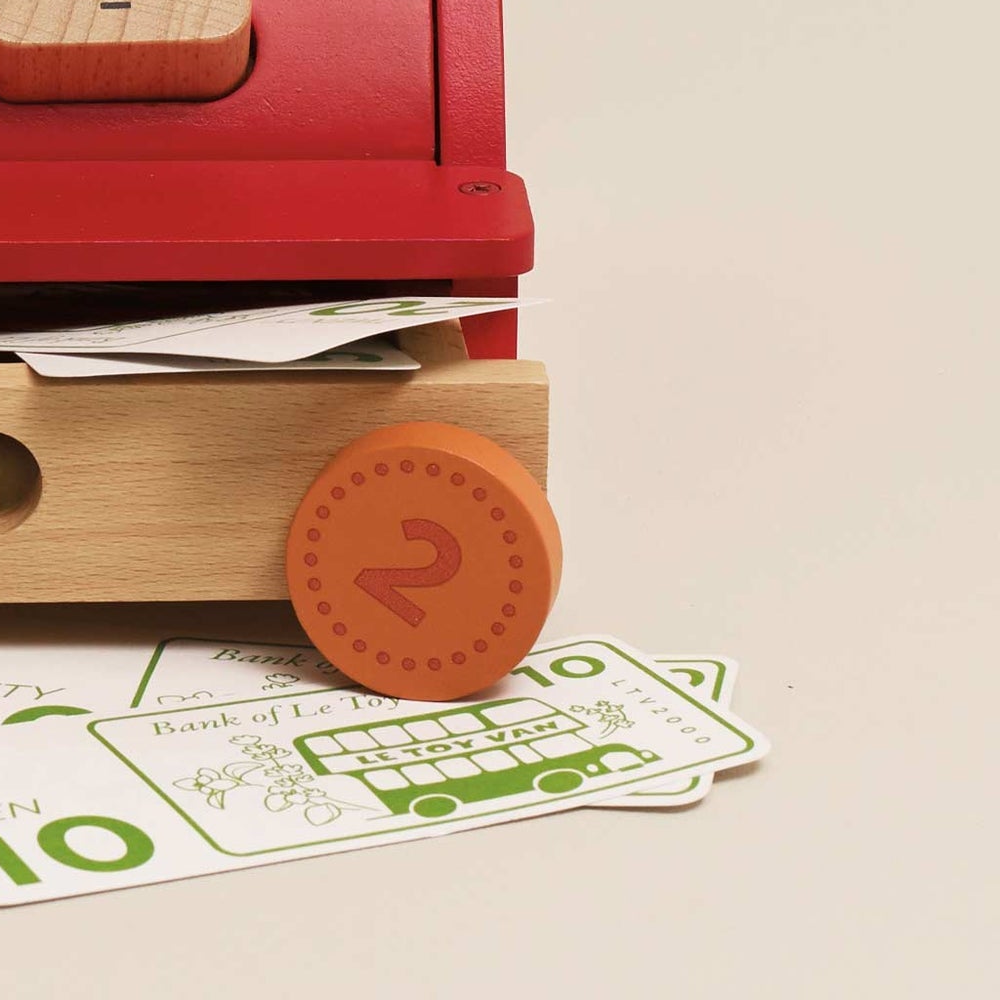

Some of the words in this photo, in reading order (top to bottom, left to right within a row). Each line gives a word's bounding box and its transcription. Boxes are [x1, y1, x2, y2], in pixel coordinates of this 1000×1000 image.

[353, 518, 463, 628] 2
[211, 648, 308, 668] Bank
[509, 655, 606, 688] 10
[151, 711, 243, 737] Bank
[251, 703, 283, 727] of
[291, 702, 333, 719] Le
[340, 694, 401, 711] Toy
[356, 751, 398, 765] LE
[406, 738, 474, 758] TOY
[485, 720, 559, 742] VAN
